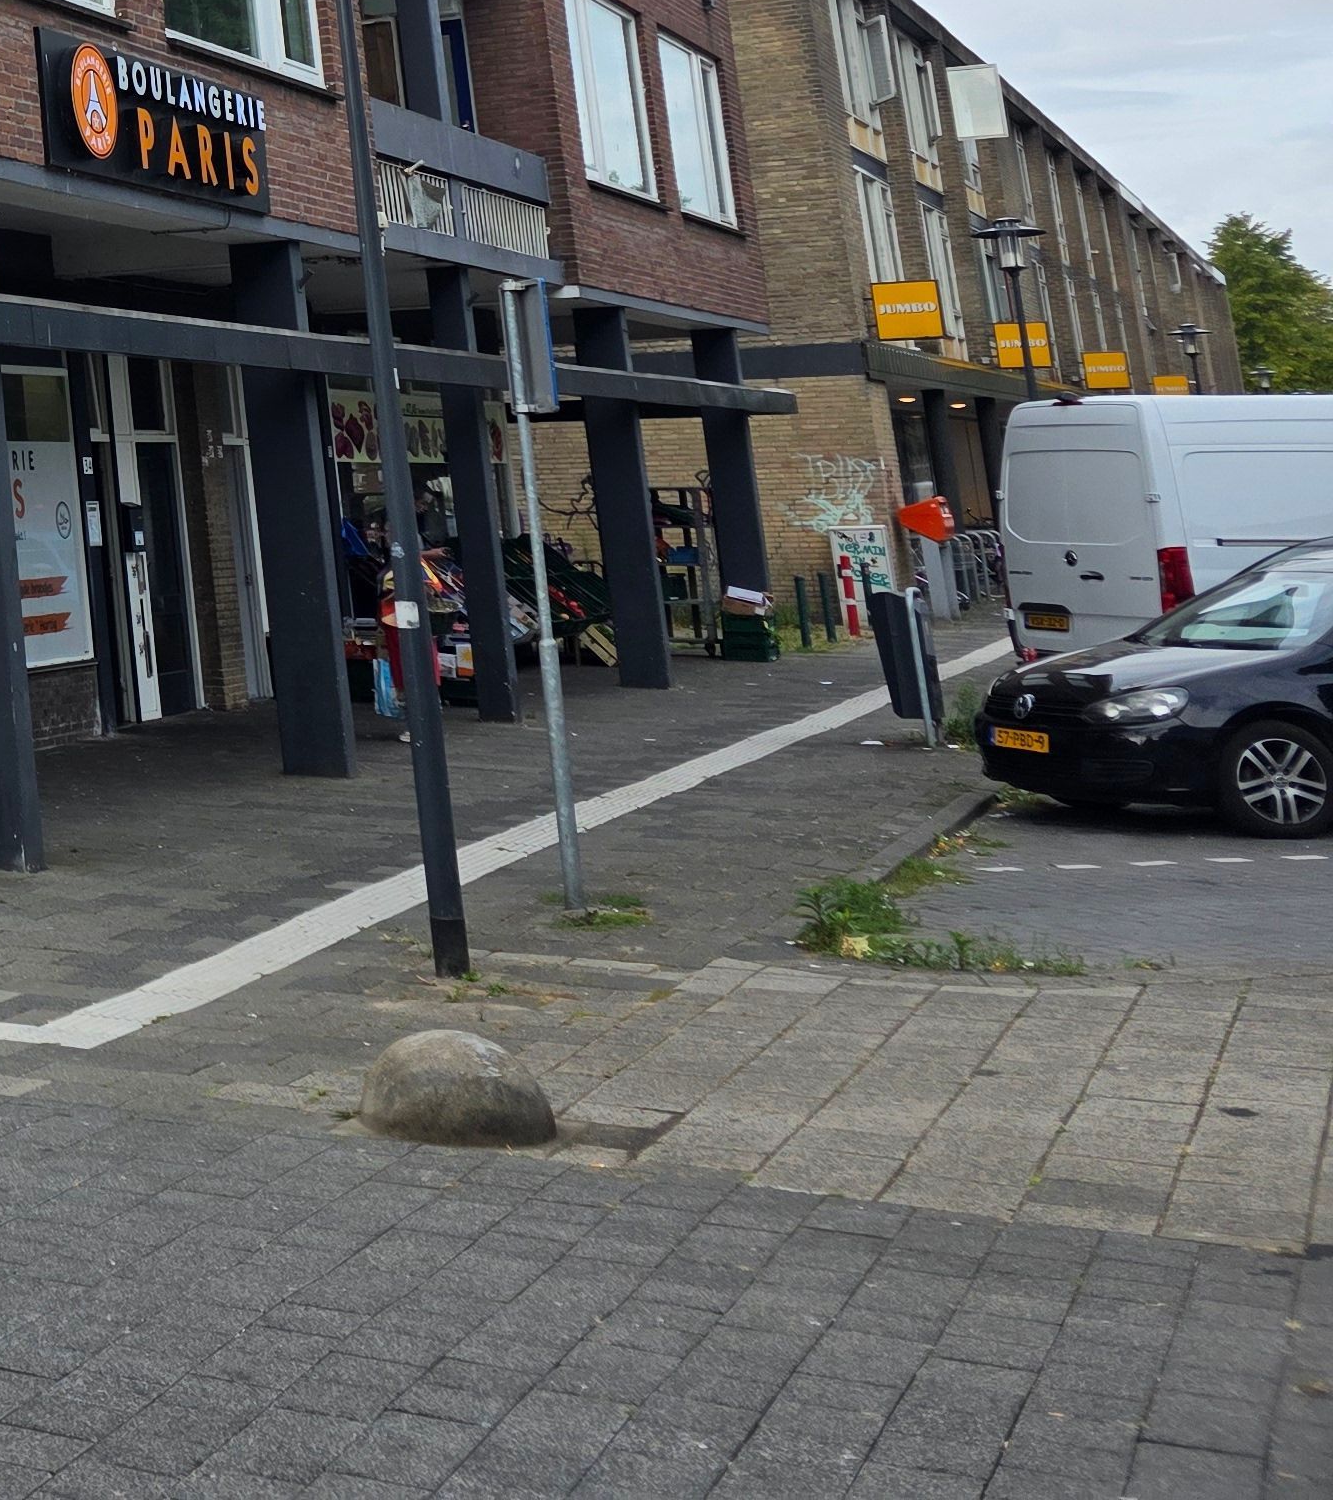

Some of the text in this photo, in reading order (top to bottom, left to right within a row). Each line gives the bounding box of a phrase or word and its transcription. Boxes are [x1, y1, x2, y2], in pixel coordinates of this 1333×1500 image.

[116, 55, 267, 131] BOULANGERIE
[84, 129, 112, 151] PARIS
[137, 106, 260, 197] PARIS
[878, 301, 937, 315] JUMBO
[1086, 363, 1127, 374] JUMBO
[997, 729, 1045, 750] 57-PBD-9
